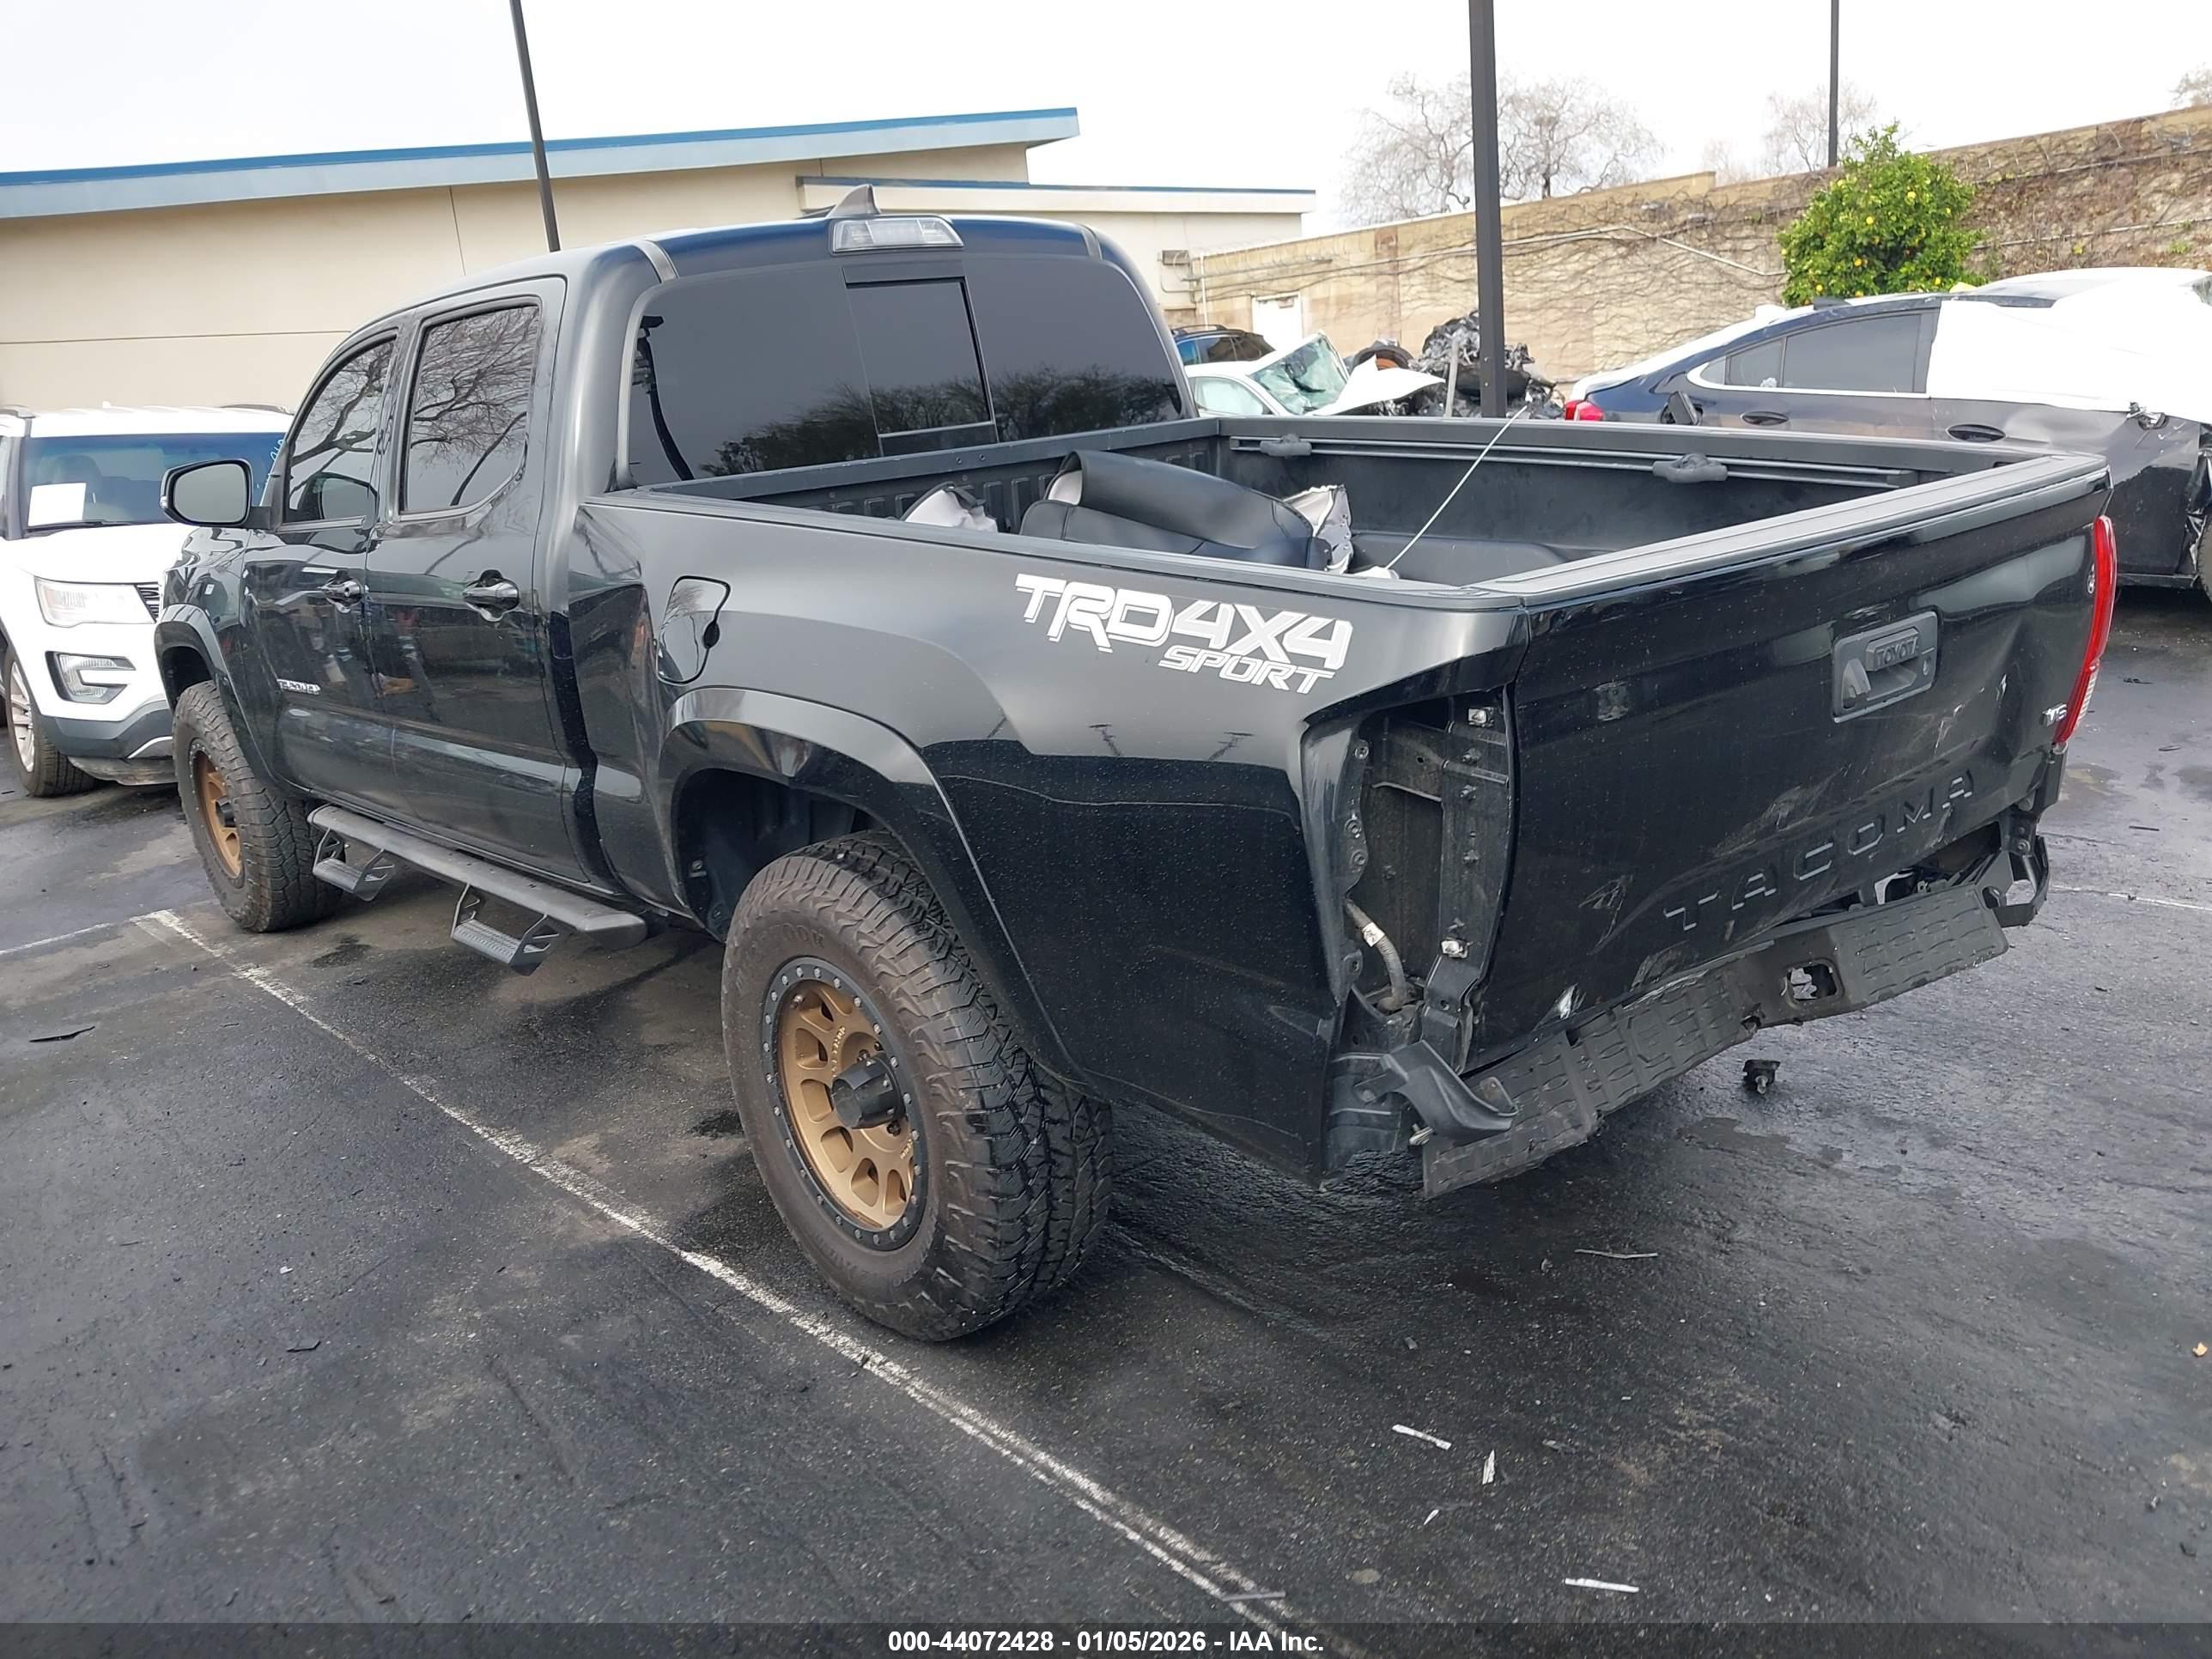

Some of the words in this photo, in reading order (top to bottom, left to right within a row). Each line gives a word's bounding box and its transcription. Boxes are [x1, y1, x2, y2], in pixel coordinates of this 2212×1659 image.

[1015, 573, 1175, 653] TRD
[1171, 599, 1354, 670] 4X4
[1158, 644, 1336, 695] SPORT
[1663, 769, 1973, 932] TACOMA
